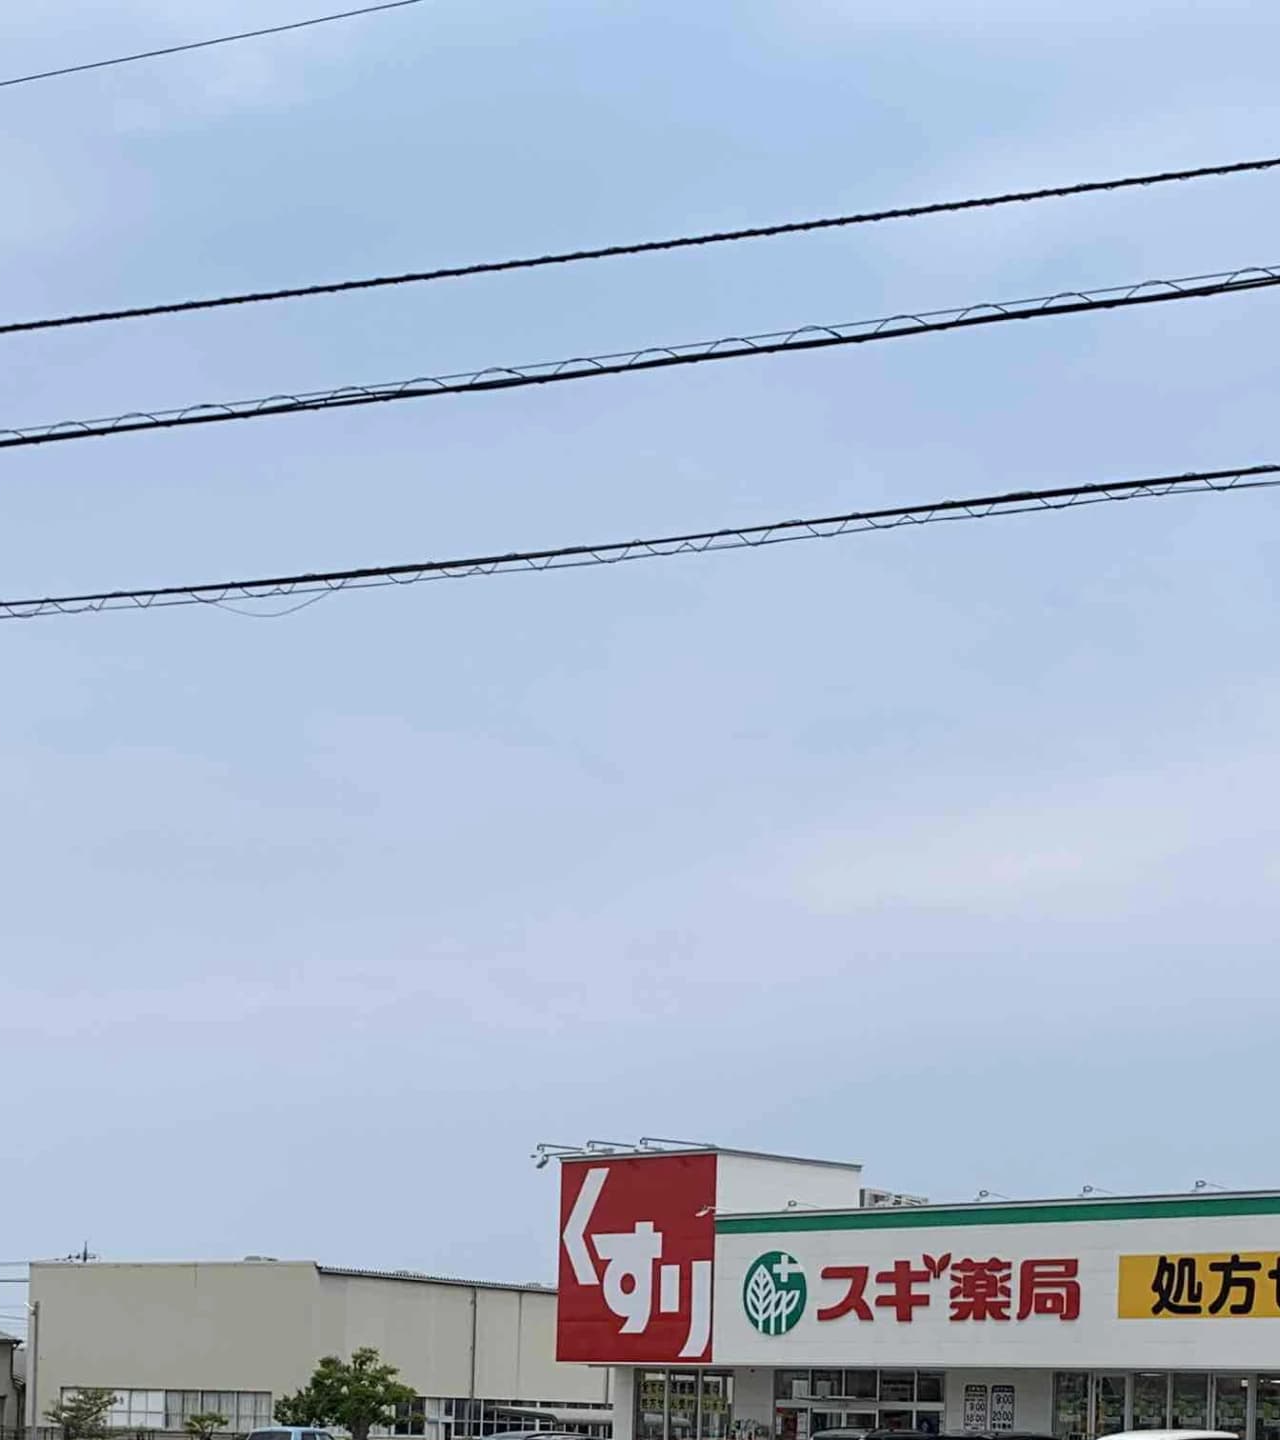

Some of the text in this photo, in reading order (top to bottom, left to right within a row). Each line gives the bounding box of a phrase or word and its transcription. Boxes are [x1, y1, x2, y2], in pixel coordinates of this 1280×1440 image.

[562, 1167, 713, 1358] くすり
[816, 1252, 1081, 1322] スギ薬局
